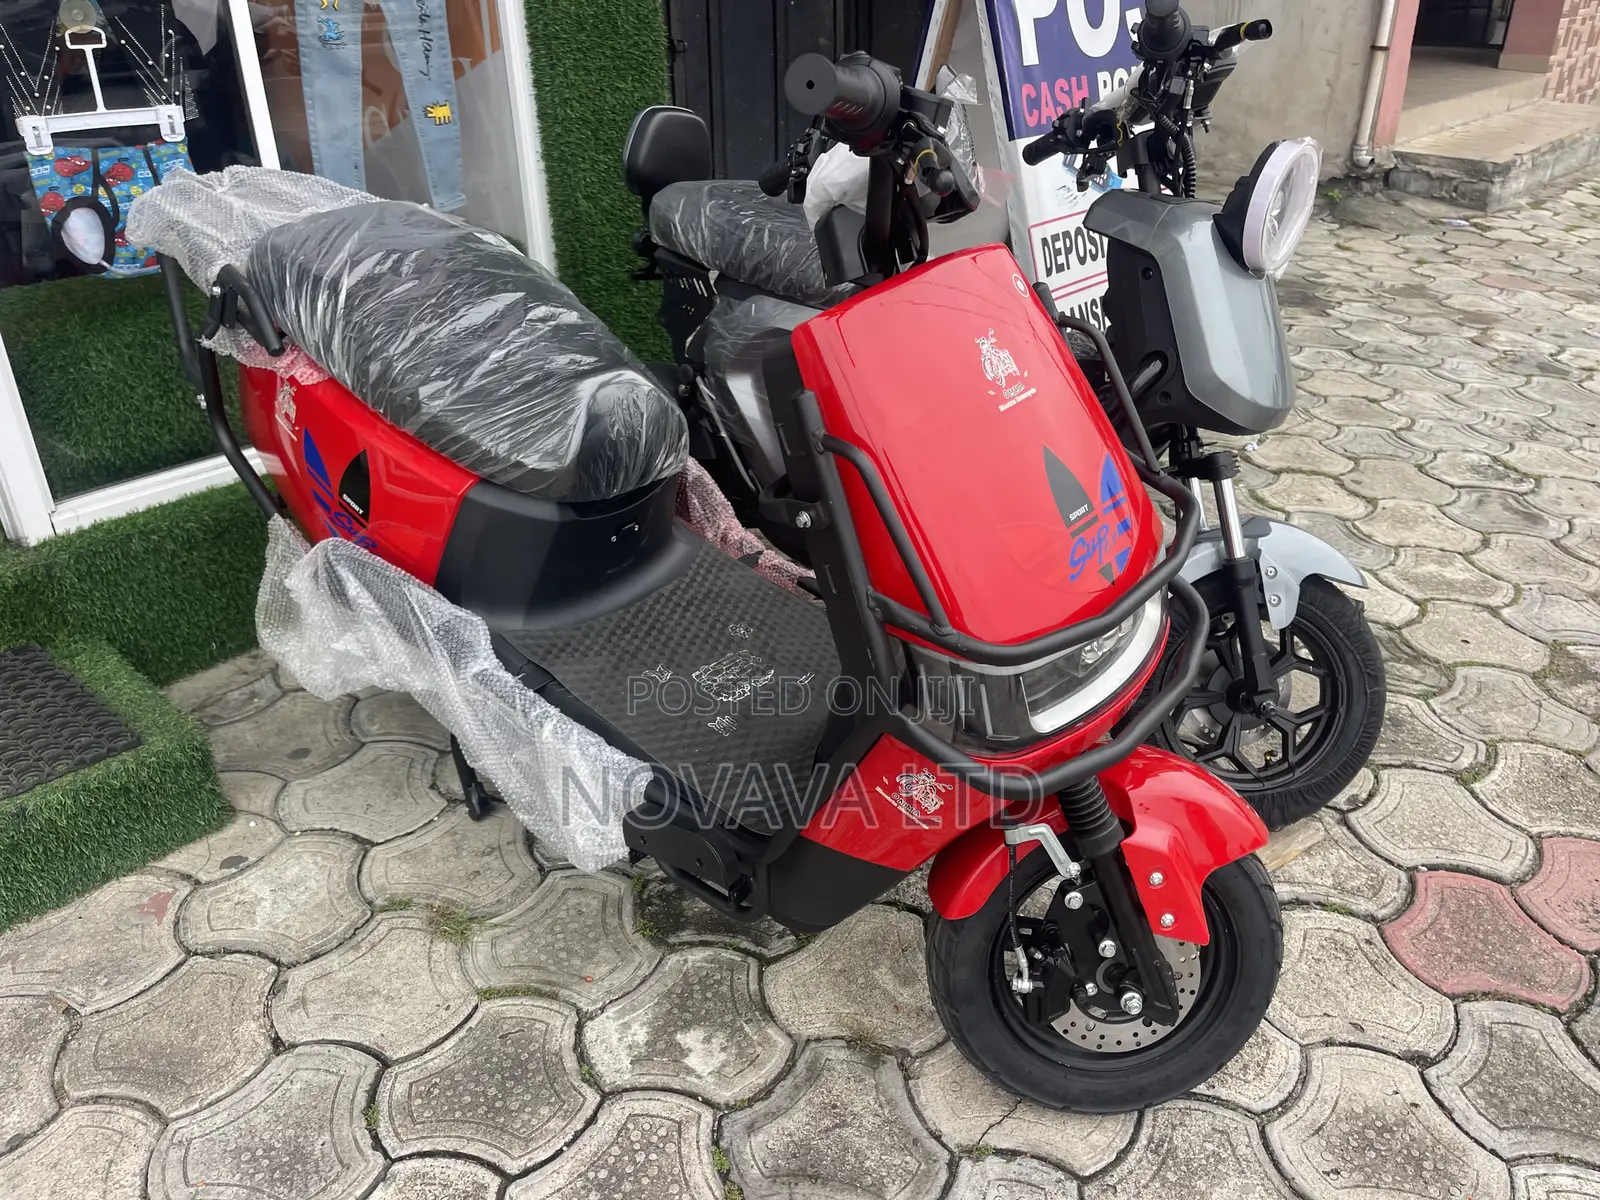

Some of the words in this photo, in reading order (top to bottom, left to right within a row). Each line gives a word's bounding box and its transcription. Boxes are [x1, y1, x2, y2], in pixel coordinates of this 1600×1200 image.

[1014, 0, 1142, 66] PO
[1021, 75, 1089, 128] CASH
[1097, 66, 1138, 101] PO
[342, 493, 364, 515] SPORT
[1069, 504, 1089, 521] SPORT
